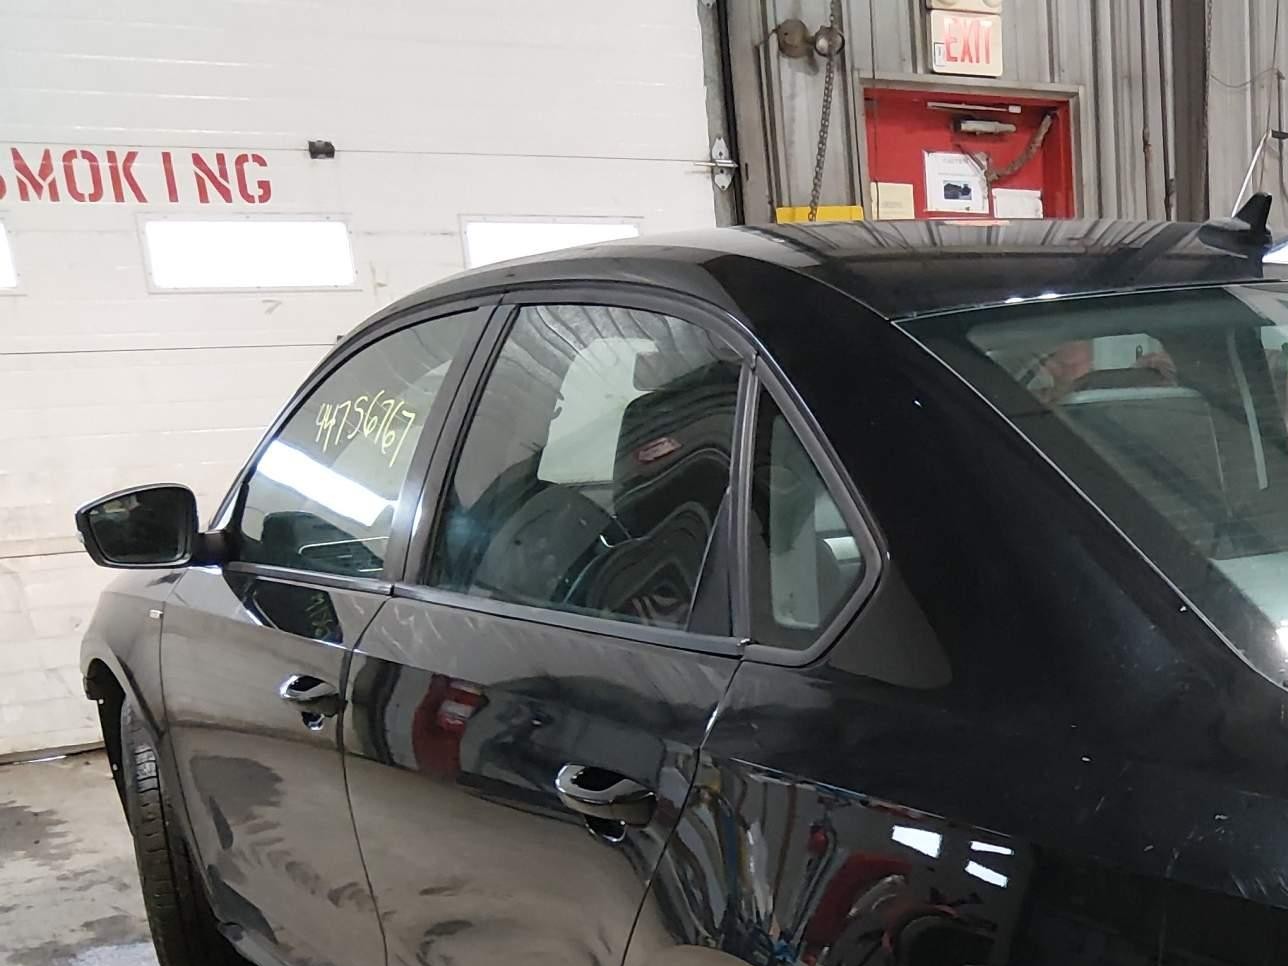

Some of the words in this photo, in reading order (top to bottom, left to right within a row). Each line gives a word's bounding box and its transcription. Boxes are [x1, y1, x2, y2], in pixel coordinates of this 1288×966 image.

[944, 17, 992, 64] EXIT
[0, 147, 272, 204] MOKING
[315, 390, 416, 468] 44756767
